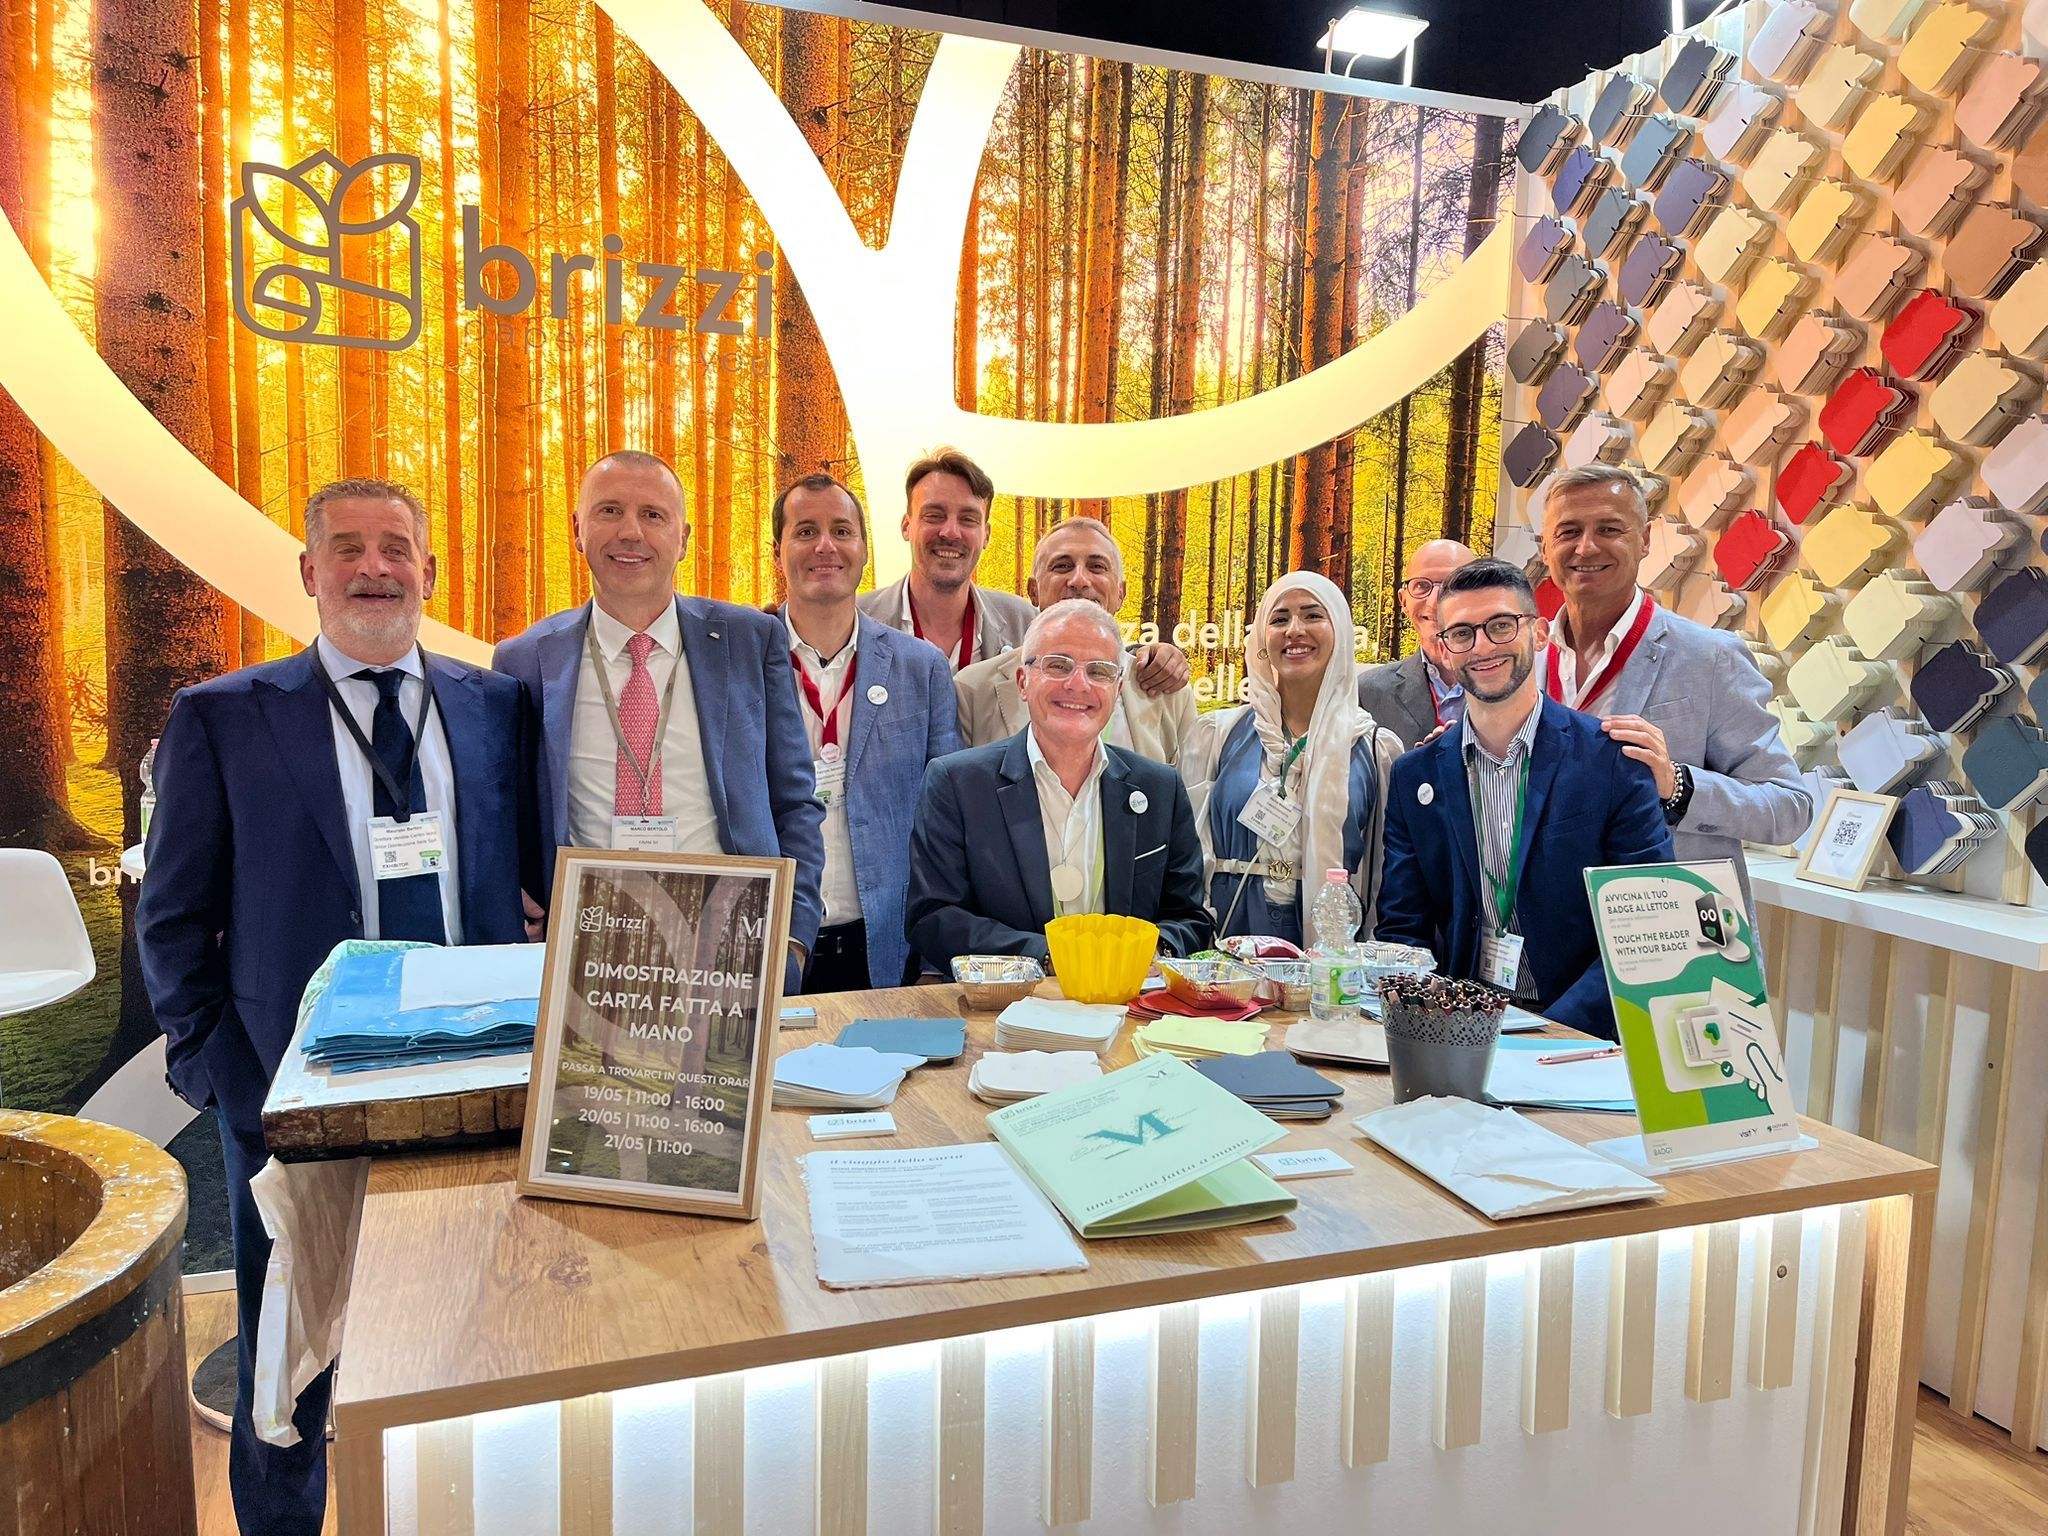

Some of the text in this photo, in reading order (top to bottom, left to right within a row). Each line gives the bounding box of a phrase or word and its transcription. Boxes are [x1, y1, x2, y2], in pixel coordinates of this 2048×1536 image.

[462, 204, 775, 338] brizzi
[1119, 621, 1160, 647] za
[1193, 662, 1250, 702] elle
[1605, 890, 1668, 903] AVVICINA IL TUO
[1607, 901, 1680, 915] BADGE AL LETTORE
[605, 912, 647, 930] brizzi
[1613, 930, 1690, 944] TOUCH THE READER
[1616, 942, 1689, 956] WITH YOUR BADGE
[584, 961, 753, 990] DIMOSTRAZIONE
[587, 990, 743, 1018] CARTA FATTA A
[629, 1022, 694, 1043] MANO
[561, 1061, 595, 1074] PASSA
[598, 1065, 607, 1075] A
[608, 1066, 663, 1081] TROVARCI
[664, 1072, 676, 1082] IN
[678, 1072, 717, 1086] QUESTI
[583, 1085, 623, 1101] 19/05
[635, 1090, 671, 1107] 11:00
[684, 1095, 725, 1112] 16:00
[578, 1108, 622, 1125] 20/05
[634, 1113, 670, 1130] 11:00
[684, 1118, 725, 1136] 16:00
[604, 1134, 644, 1151] 21/05
[656, 1139, 693, 1156] 11:00
